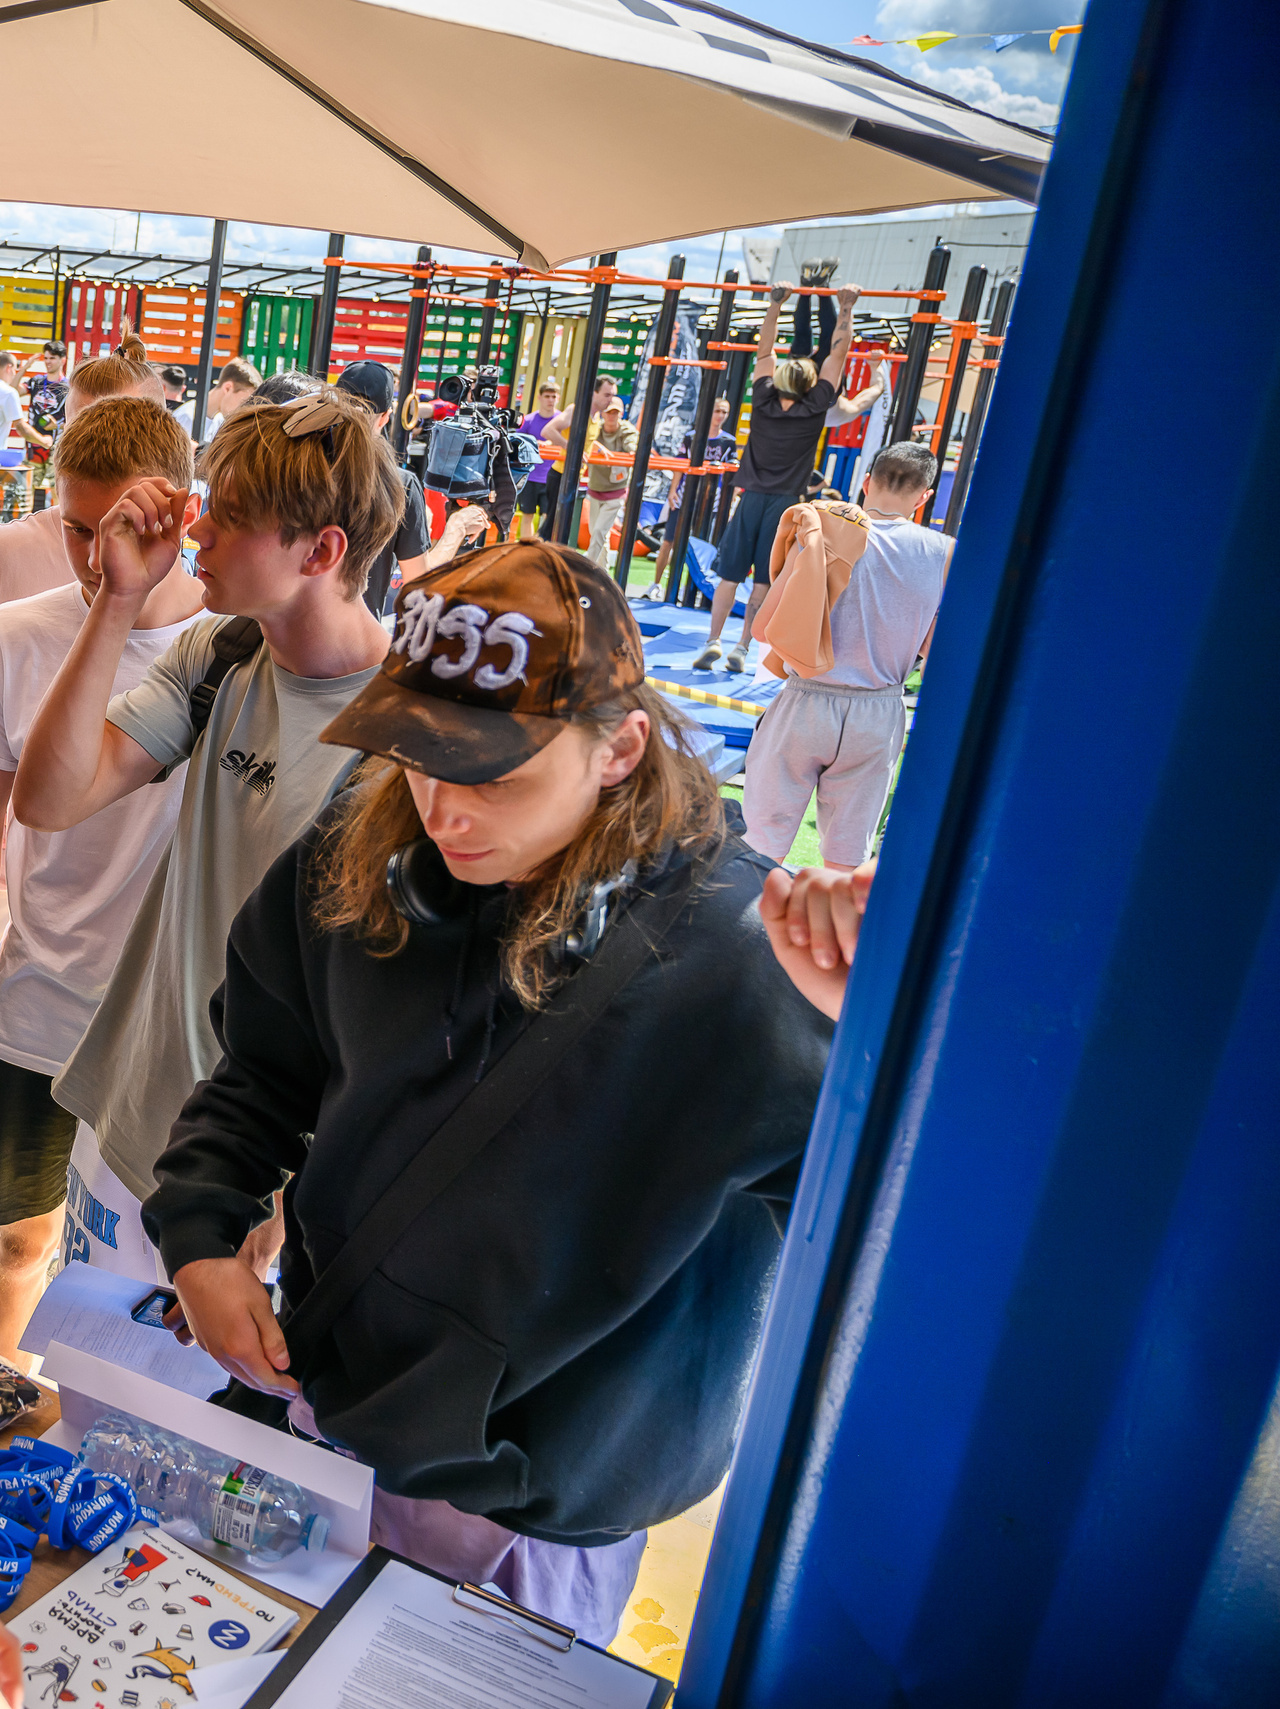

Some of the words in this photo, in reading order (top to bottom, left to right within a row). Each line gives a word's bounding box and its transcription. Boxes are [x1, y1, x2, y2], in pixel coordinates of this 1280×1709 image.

[77, 1180, 121, 1251] YORK
[73, 1493, 114, 1531] WORKOUT
[87, 1510, 125, 1552] WORKOUT
[48, 1606, 101, 1645] ВРЕМЯ
[56, 1599, 107, 1636] ТВОРИТЬ:
[67, 1590, 118, 1628] СТИЛЬ
